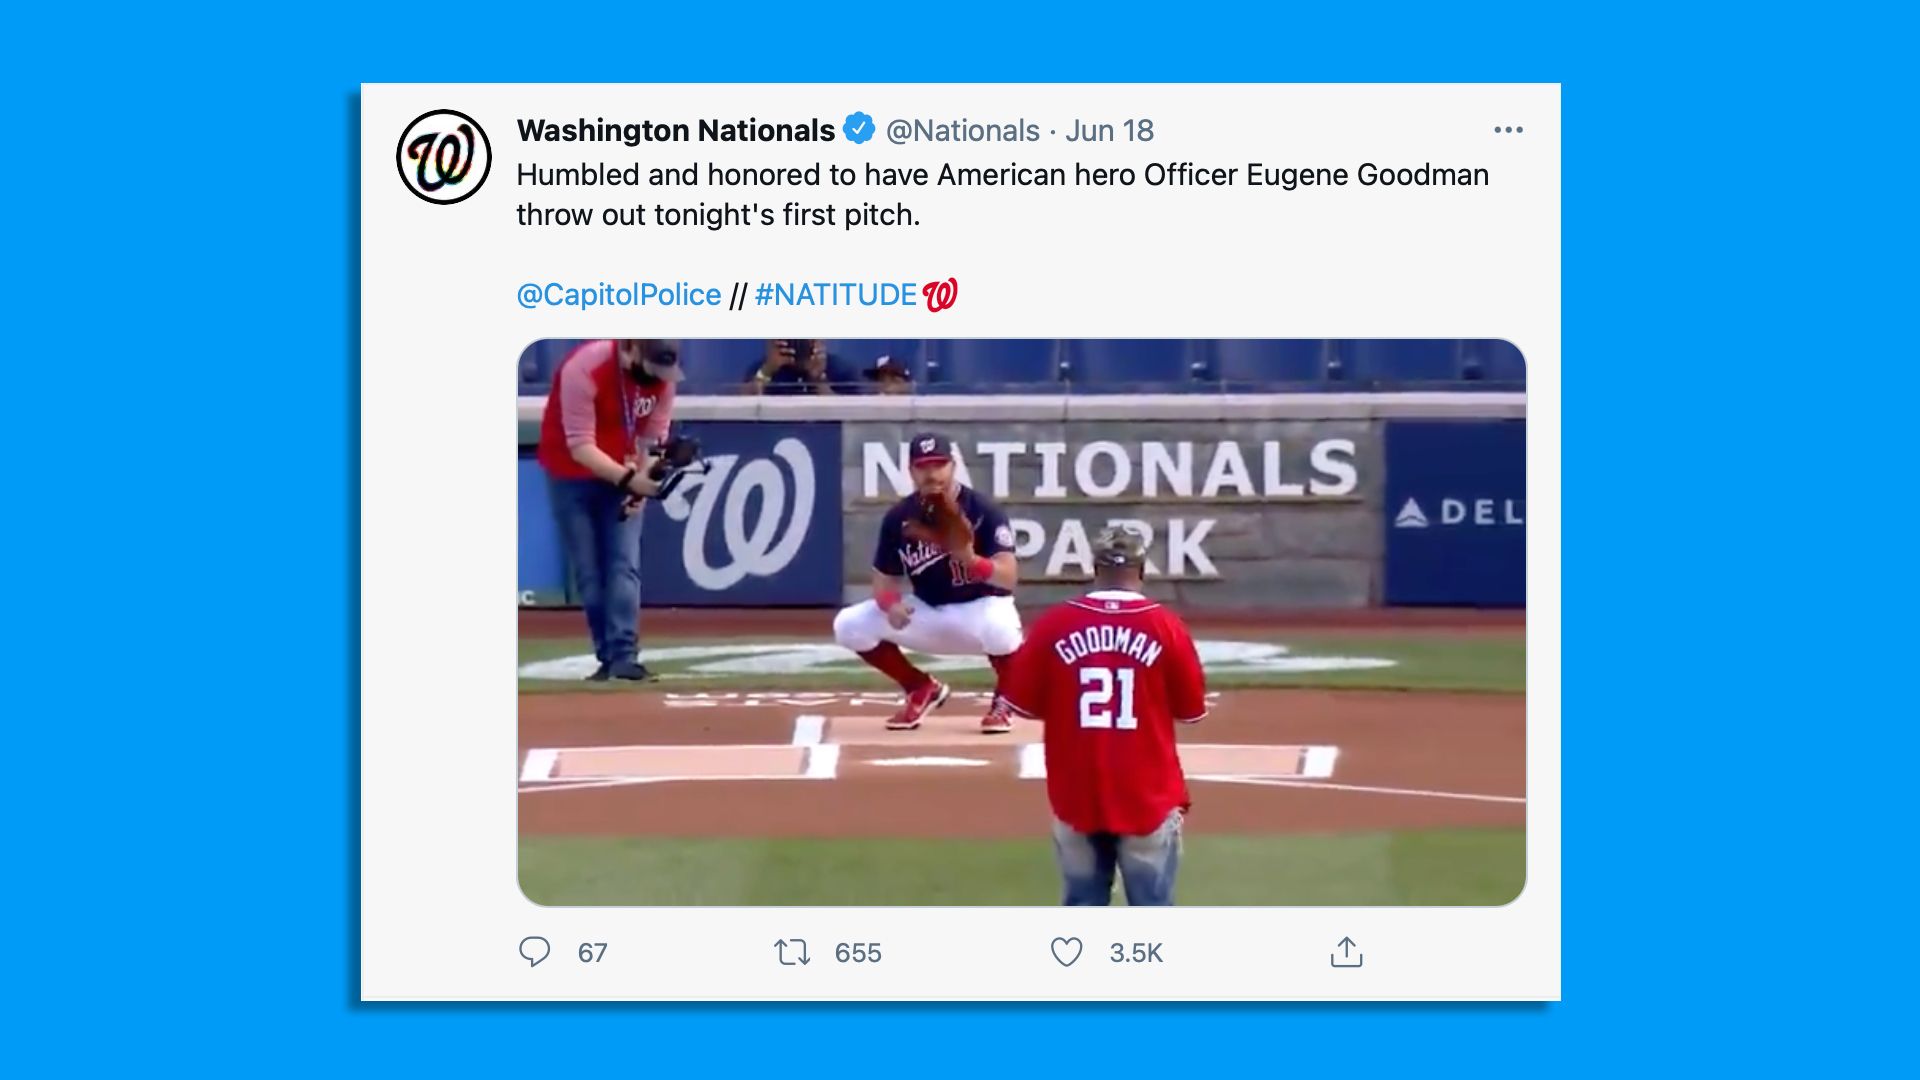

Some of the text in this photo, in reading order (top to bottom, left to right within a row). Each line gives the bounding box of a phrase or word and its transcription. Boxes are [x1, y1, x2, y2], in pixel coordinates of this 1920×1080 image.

[517, 117, 1155, 147] Washington Nationals @Nationals Jun 18
[518, 161, 1489, 192] Humbled and honored to have American hero Officer Eugene Goodman
[516, 201, 920, 232] throw out tonight's first pitch.
[518, 281, 722, 312] @CapitolPolice
[729, 281, 749, 312] //
[755, 282, 917, 307] #NATITUDE
[1441, 498, 1525, 525] DEL
[1055, 625, 1163, 667] GOODMAN
[1079, 667, 1139, 730] 21
[578, 942, 608, 964] 67
[835, 942, 882, 964] 655
[1110, 942, 1164, 964] 3.5K
